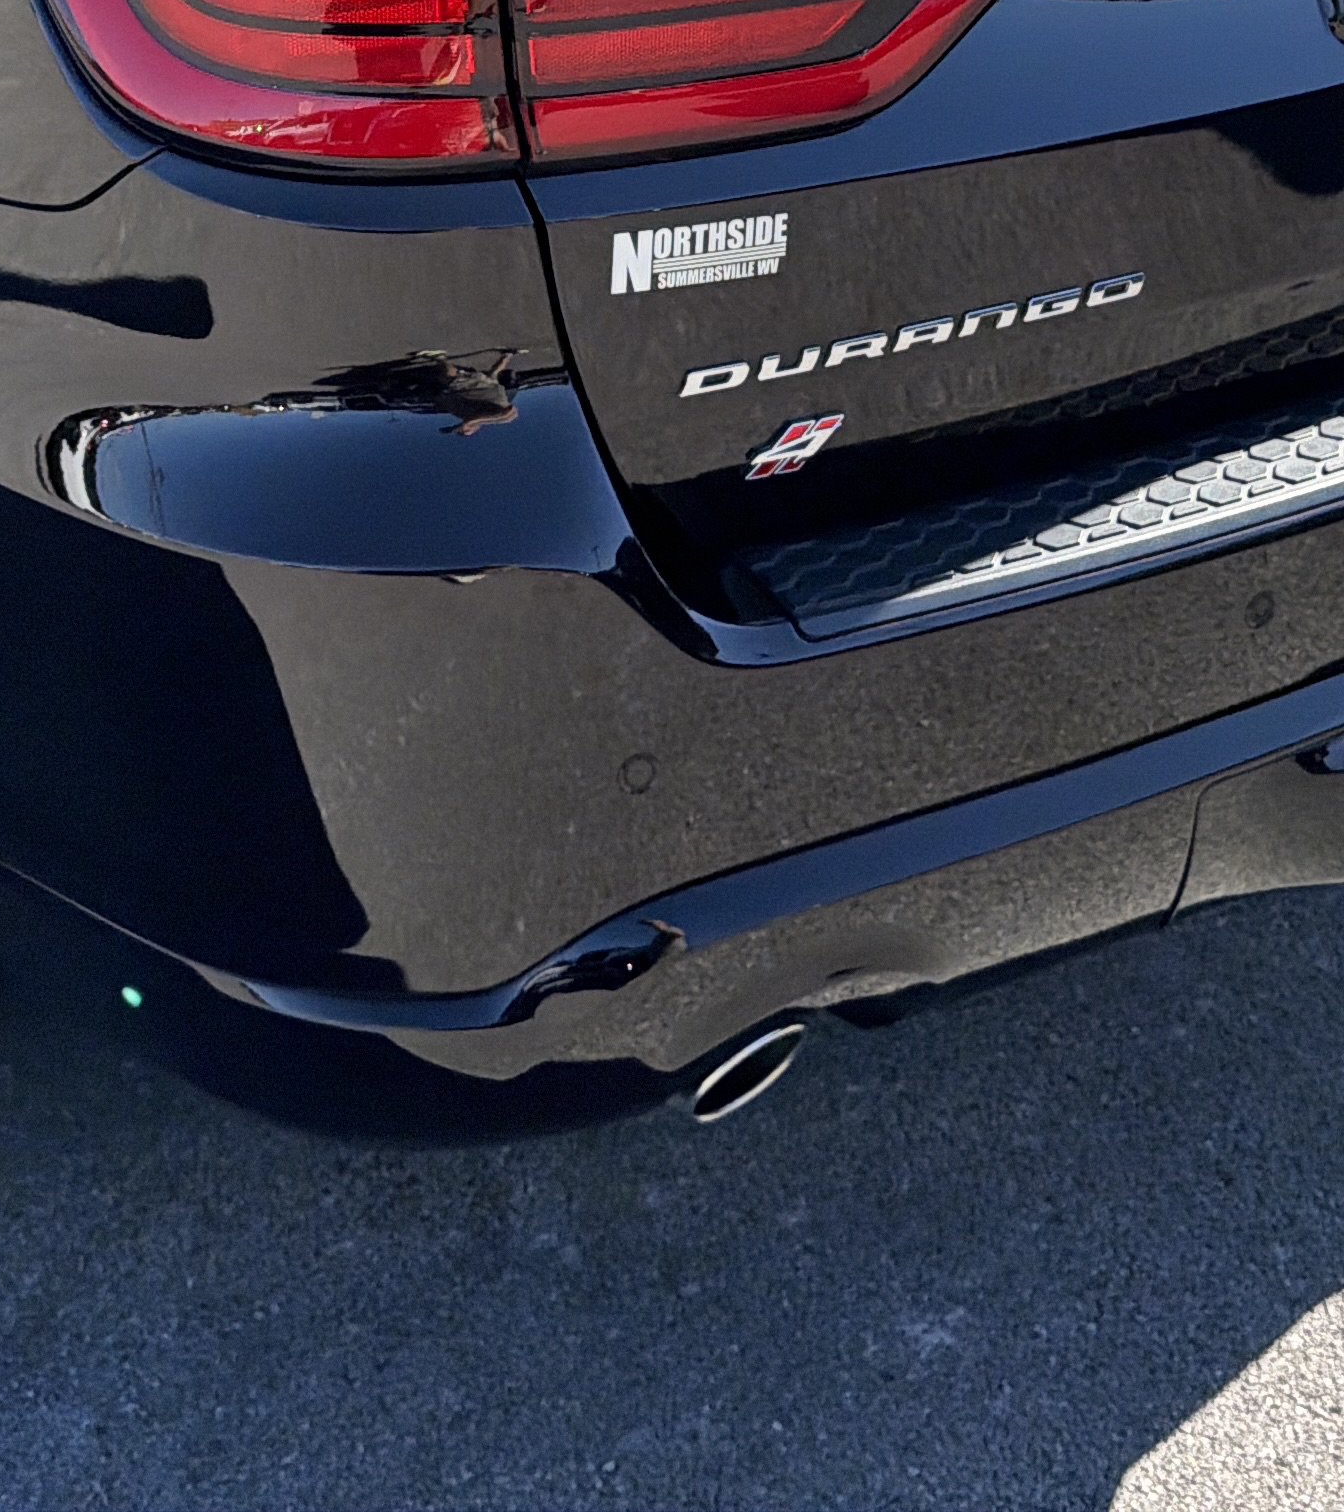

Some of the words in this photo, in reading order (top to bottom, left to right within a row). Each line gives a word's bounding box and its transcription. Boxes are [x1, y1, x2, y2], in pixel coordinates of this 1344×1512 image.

[610, 212, 789, 295] NORTHSIDE
[657, 260, 756, 290] SUMMERSVILLE
[757, 257, 781, 276] WV
[678, 271, 1146, 398] DURANGO
